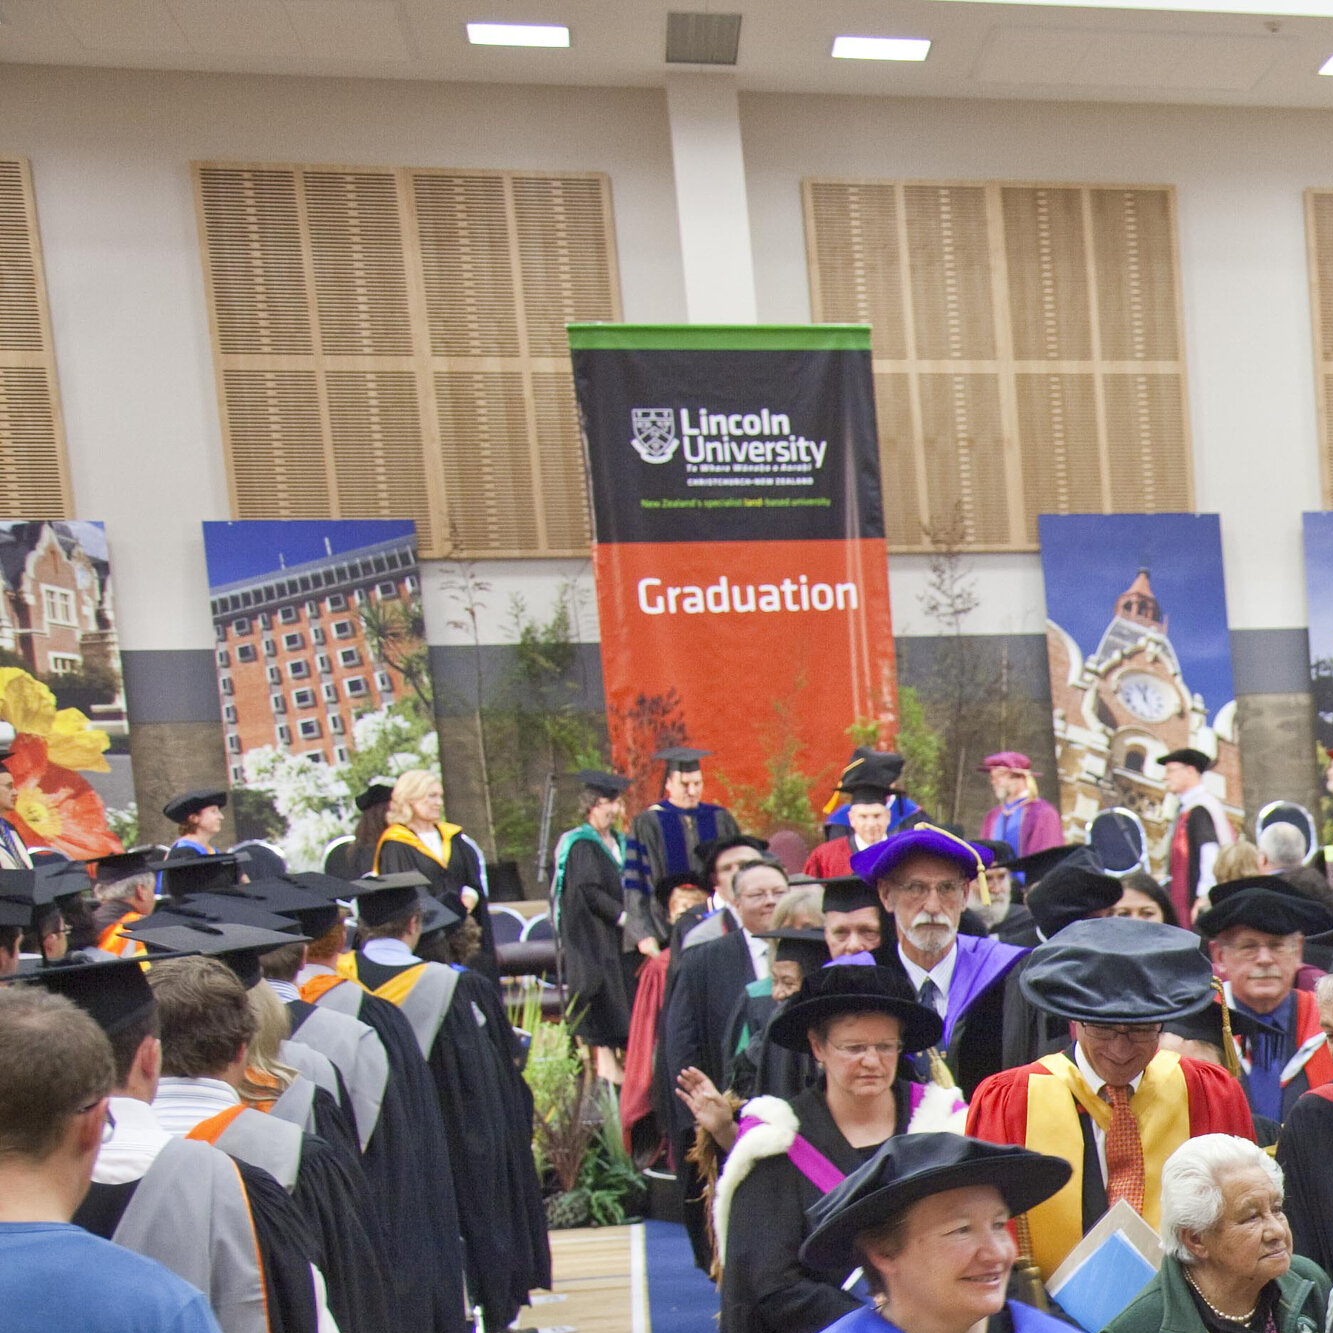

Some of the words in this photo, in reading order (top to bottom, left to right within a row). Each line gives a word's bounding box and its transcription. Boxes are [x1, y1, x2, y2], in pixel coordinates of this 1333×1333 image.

[680, 408, 790, 435] Lincoln
[682, 435, 827, 469] University
[775, 476, 815, 486] ZEALAND
[640, 499, 661, 508] New
[791, 497, 832, 507] university
[637, 574, 858, 615] Graduation
